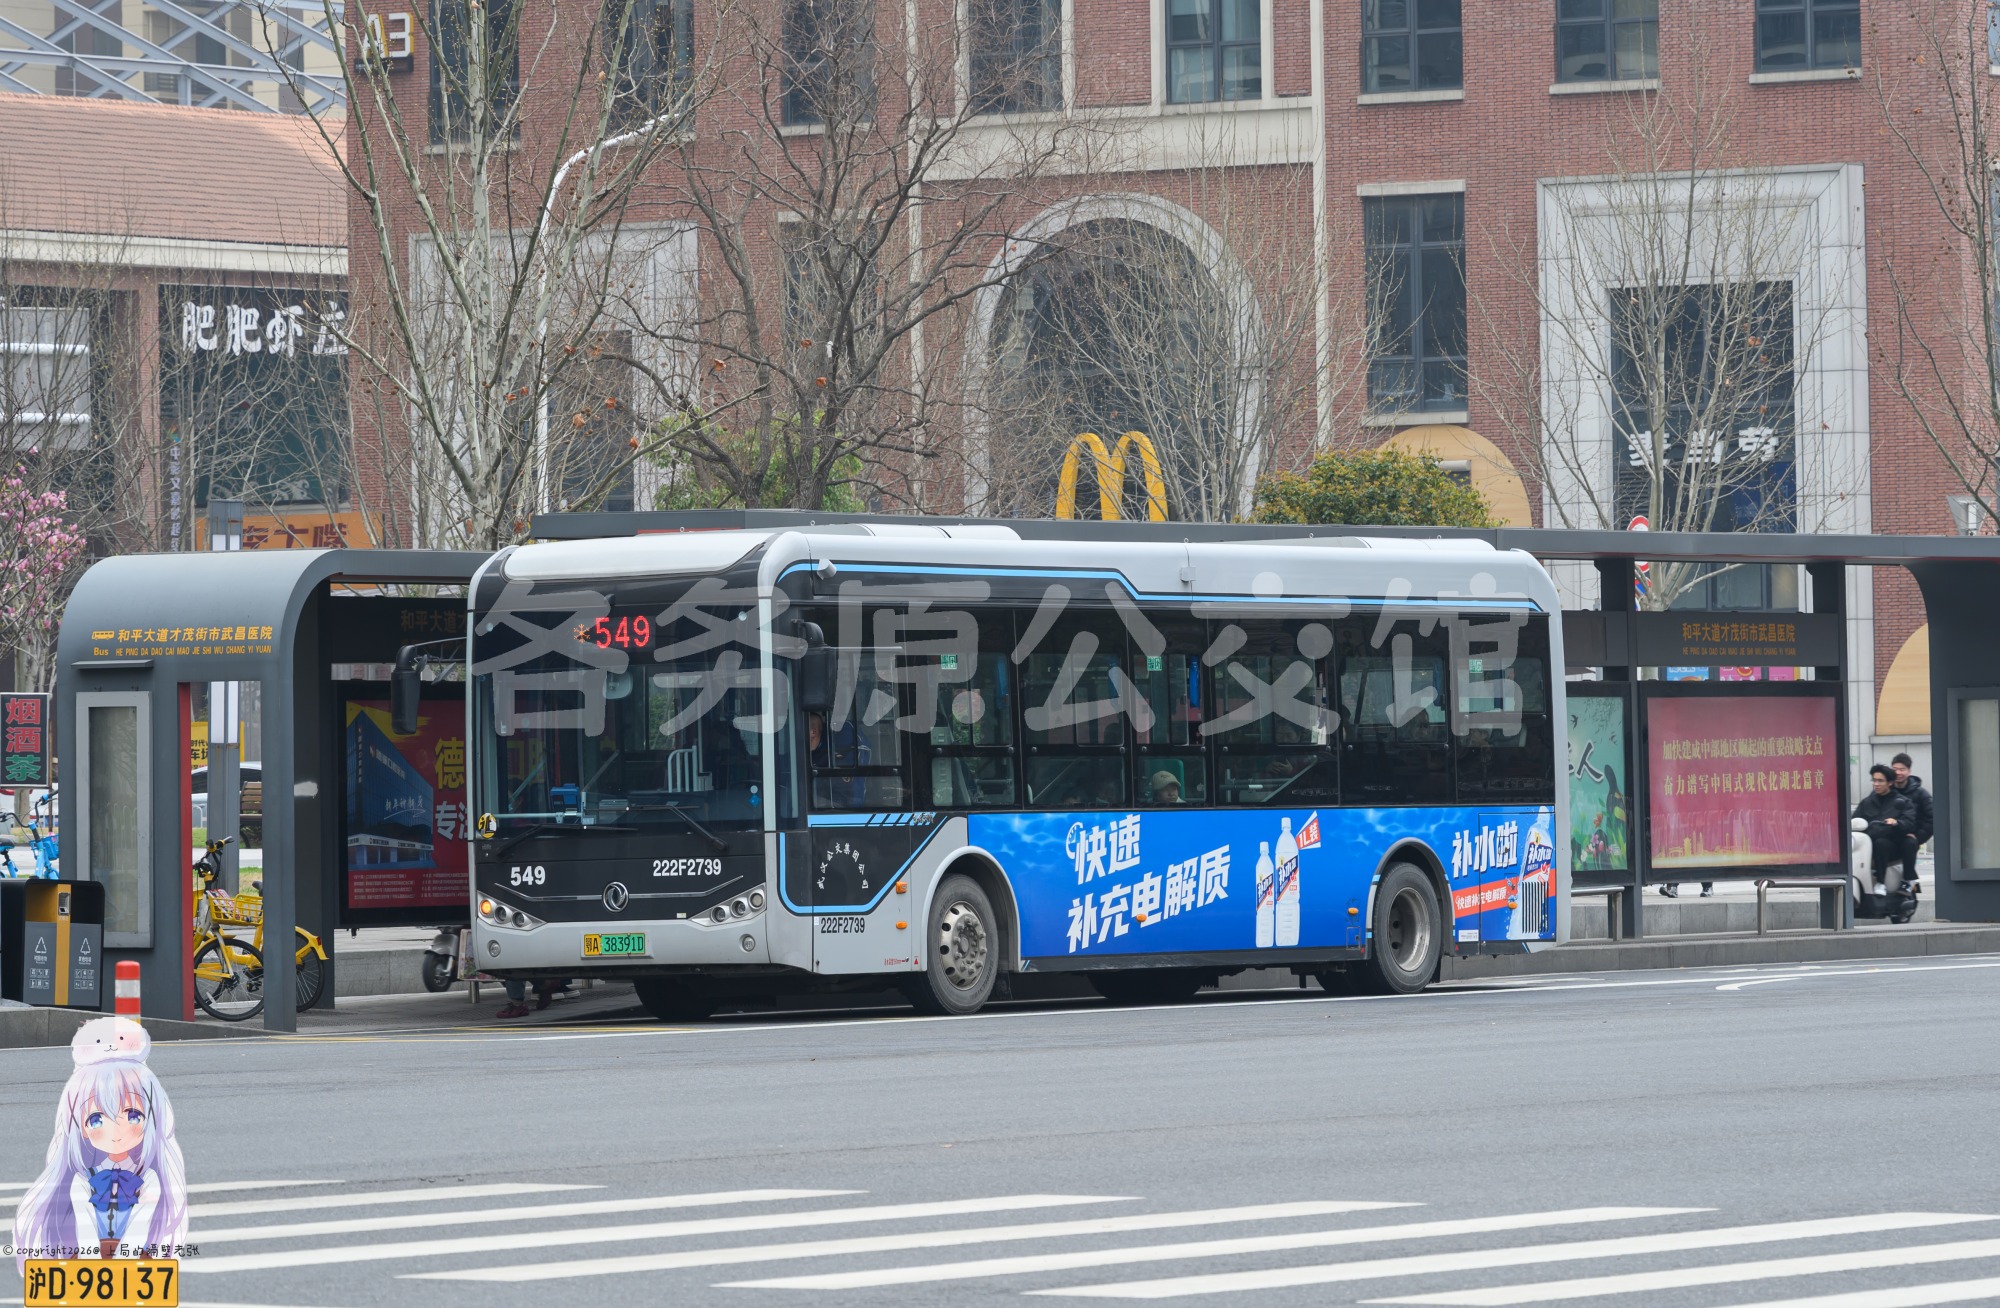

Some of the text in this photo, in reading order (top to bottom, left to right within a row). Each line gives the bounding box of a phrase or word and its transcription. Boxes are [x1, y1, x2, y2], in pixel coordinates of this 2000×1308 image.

[361, 12, 414, 58] A3
[1628, 427, 1779, 467] 麦当劳
[117, 626, 273, 643] 和平大道才茂街市武昌医院
[595, 615, 650, 649] 549
[1682, 622, 1796, 642] 和平大道才茂街市武昌医院
[93, 647, 109, 656] Bus
[116, 648, 123, 656] HE
[126, 648, 138, 656] PING
[141, 648, 148, 656] DA
[151, 648, 163, 656] DAO
[166, 648, 174, 656] CAI
[177, 647, 190, 656] MAO
[203, 646, 212, 655] SHI
[214, 646, 223, 654] WU
[226, 646, 245, 654] CHANG
[248, 646, 253, 654] YI
[256, 646, 272, 654] YUAN
[5, 697, 41, 781] 烟酒茶
[1663, 735, 1823, 761] 加快建成中部地区崛起的重要战略支点
[1568, 739, 1604, 782] 人
[1663, 769, 1824, 796] 奋力谱写中国式现代化湖北篇章
[1299, 822, 1318, 848] 1L装
[1074, 813, 1141, 886] 快速
[1452, 820, 1518, 878] 补水啦
[510, 866, 546, 886] 549
[653, 859, 722, 877] 222F2739
[1066, 844, 1231, 954] 补充电解质
[820, 916, 865, 934] 222F2739
